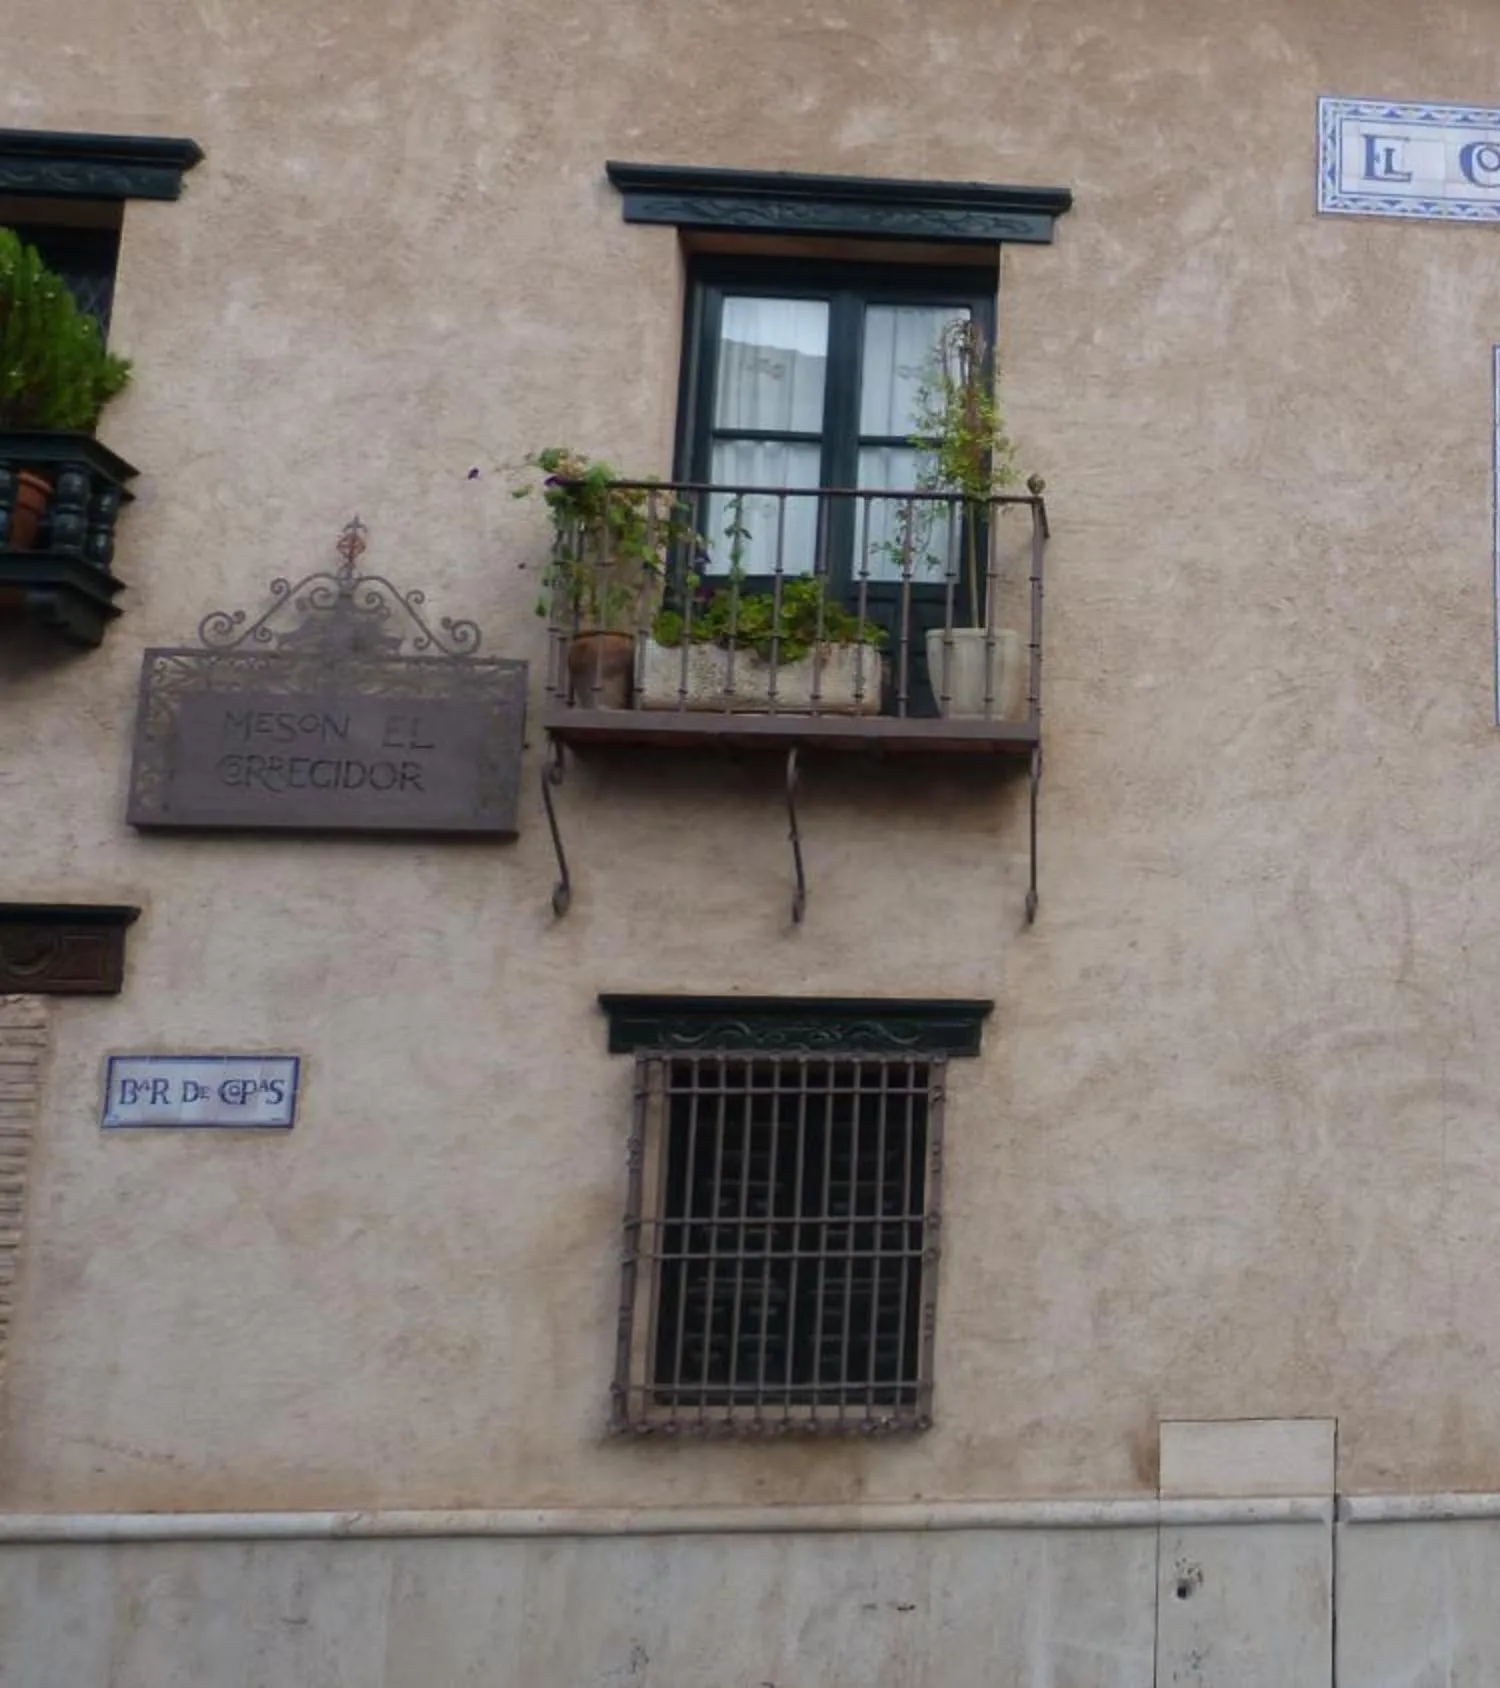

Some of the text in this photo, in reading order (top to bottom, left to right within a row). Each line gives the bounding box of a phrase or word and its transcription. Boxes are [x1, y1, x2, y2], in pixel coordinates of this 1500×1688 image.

[1360, 133, 1412, 183] EL
[224, 709, 436, 749] MESON EL
[119, 1077, 172, 1105] BAR
[182, 1079, 210, 1103] DE
